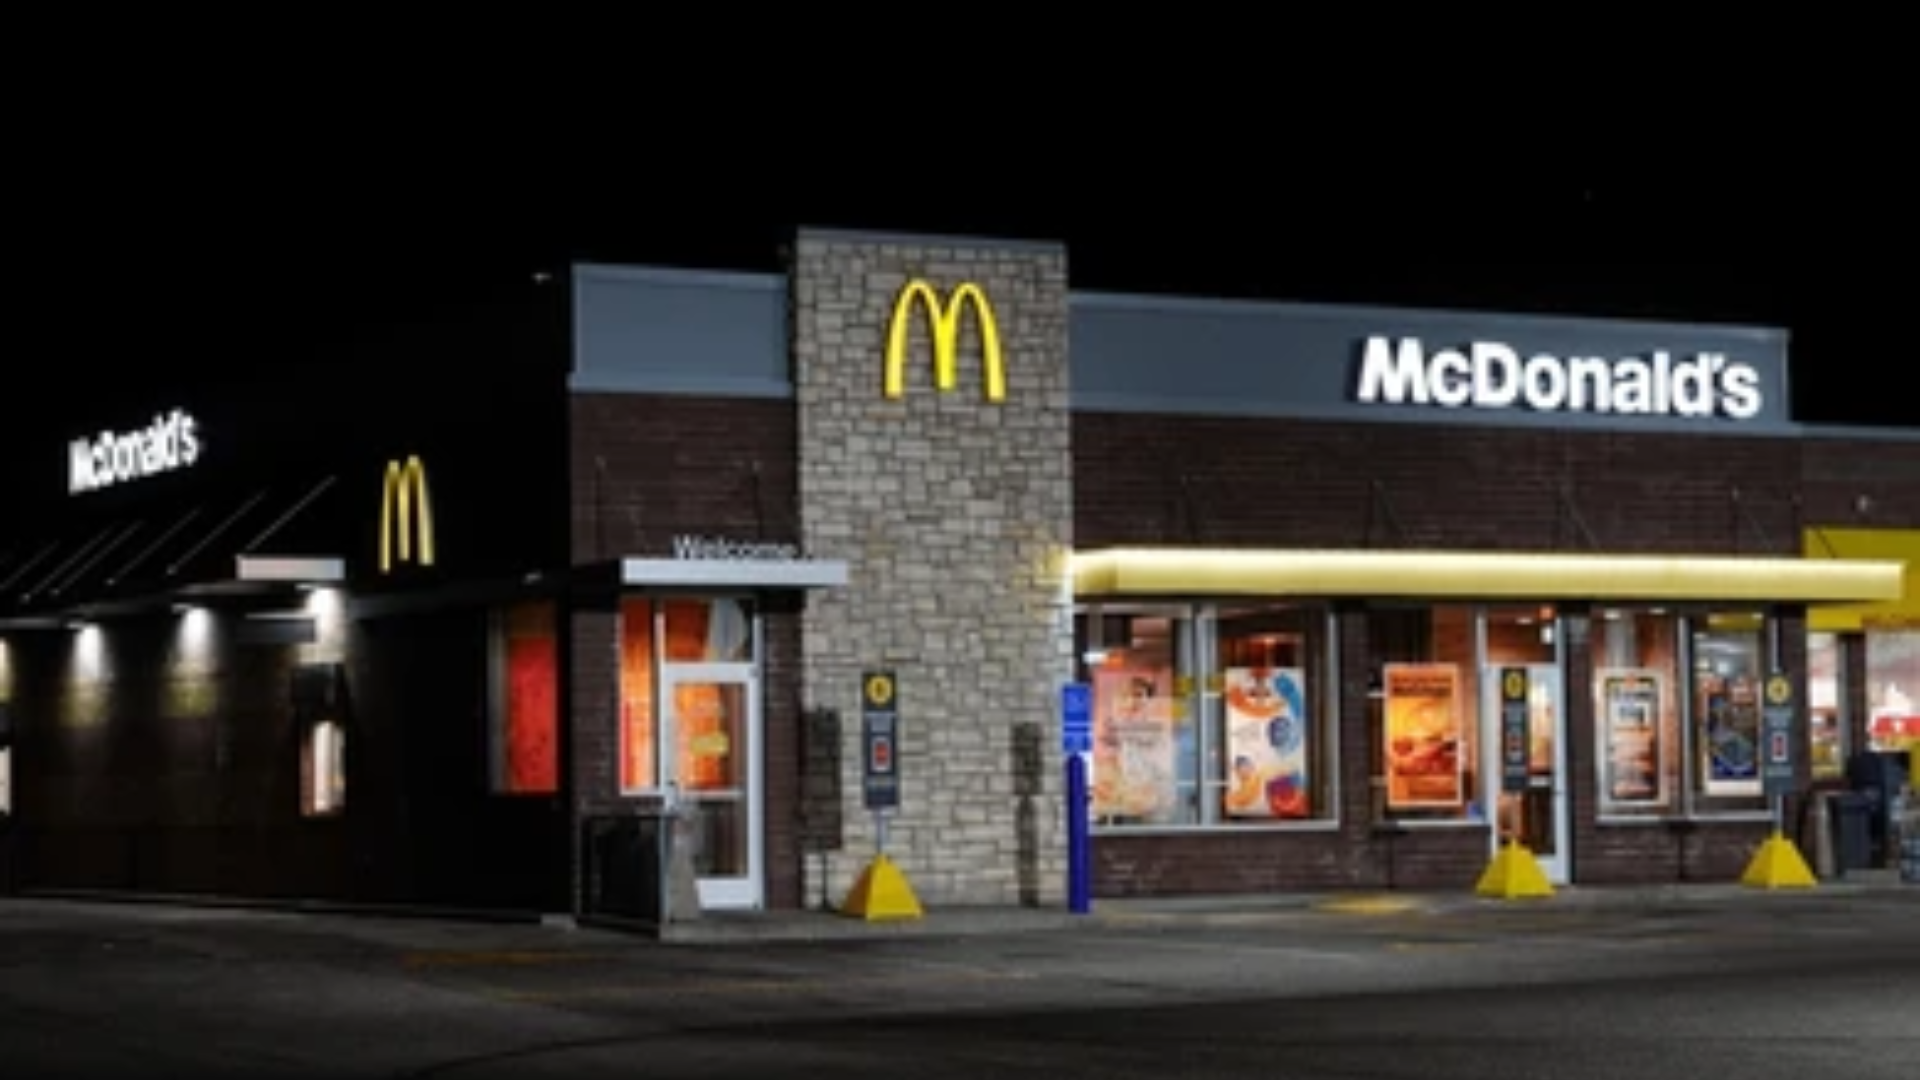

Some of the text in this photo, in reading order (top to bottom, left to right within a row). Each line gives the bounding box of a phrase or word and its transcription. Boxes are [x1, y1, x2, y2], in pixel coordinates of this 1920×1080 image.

[1359, 337, 1760, 418] McDonald's
[69, 409, 200, 493] McDonald's
[673, 535, 797, 560] Welcome
